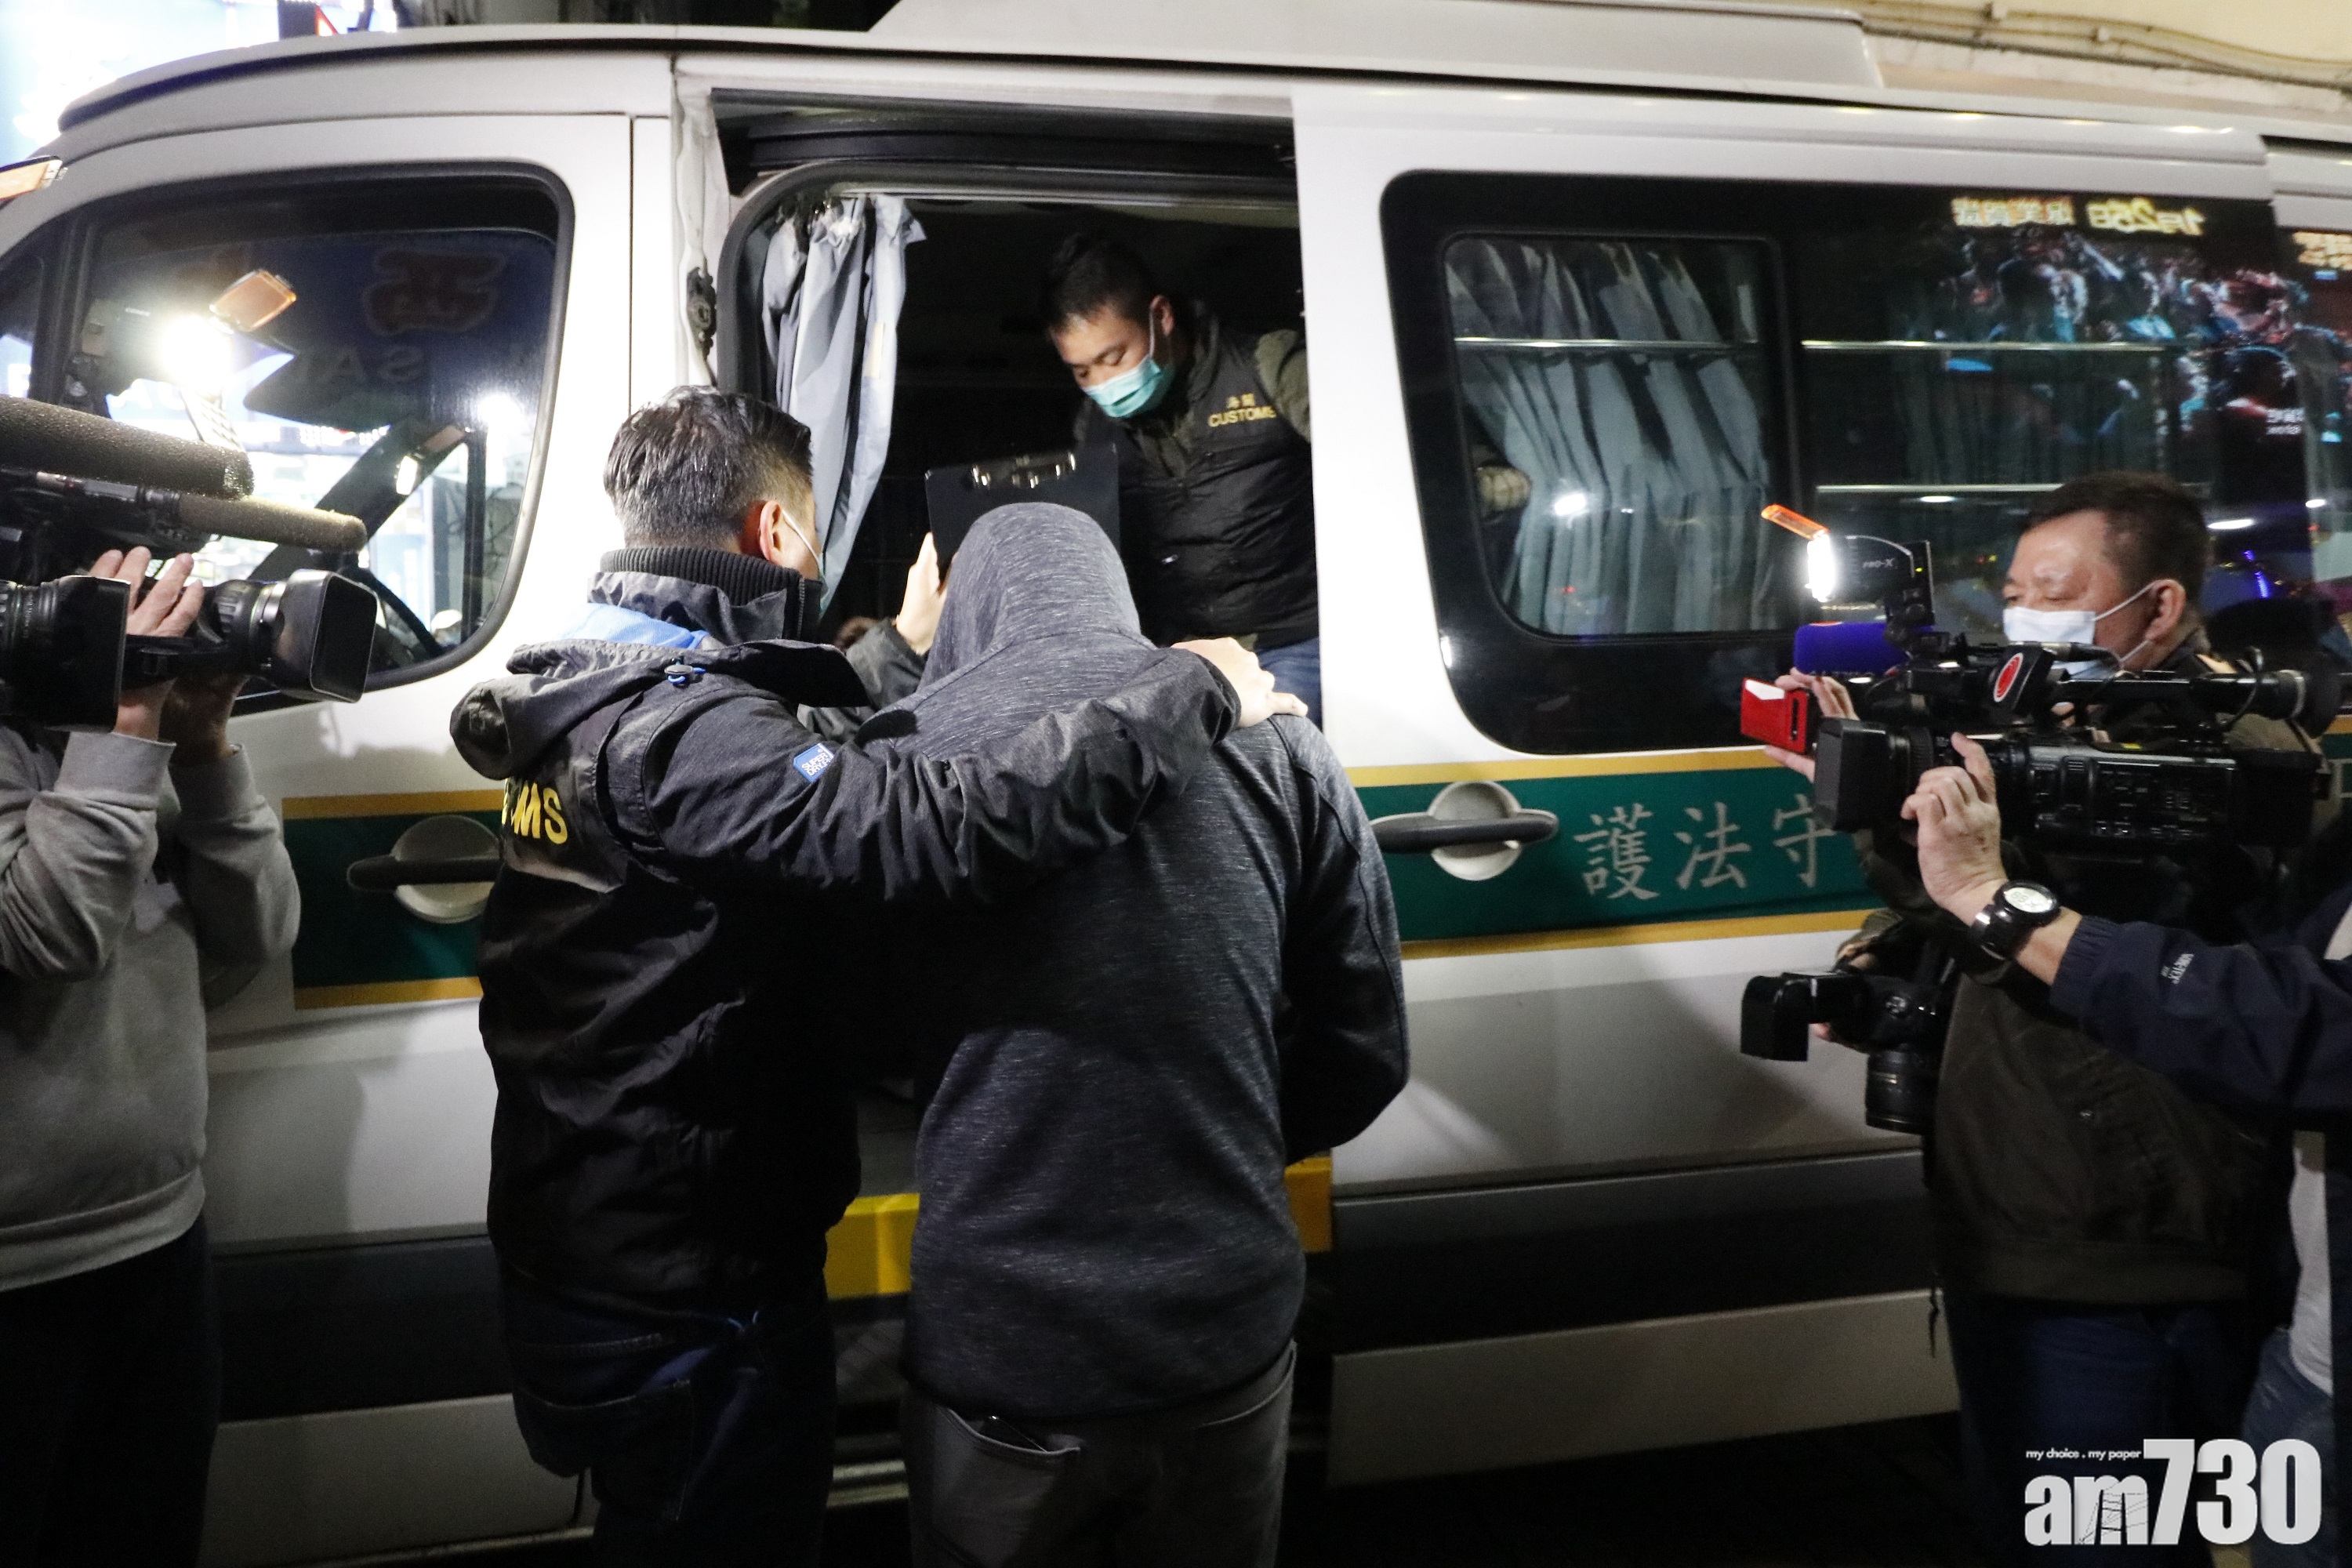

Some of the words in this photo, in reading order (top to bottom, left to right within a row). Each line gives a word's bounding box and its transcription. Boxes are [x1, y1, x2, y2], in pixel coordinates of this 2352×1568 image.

[801, 753, 829, 771] SUPER
[1573, 793, 1837, 900] 護法守
